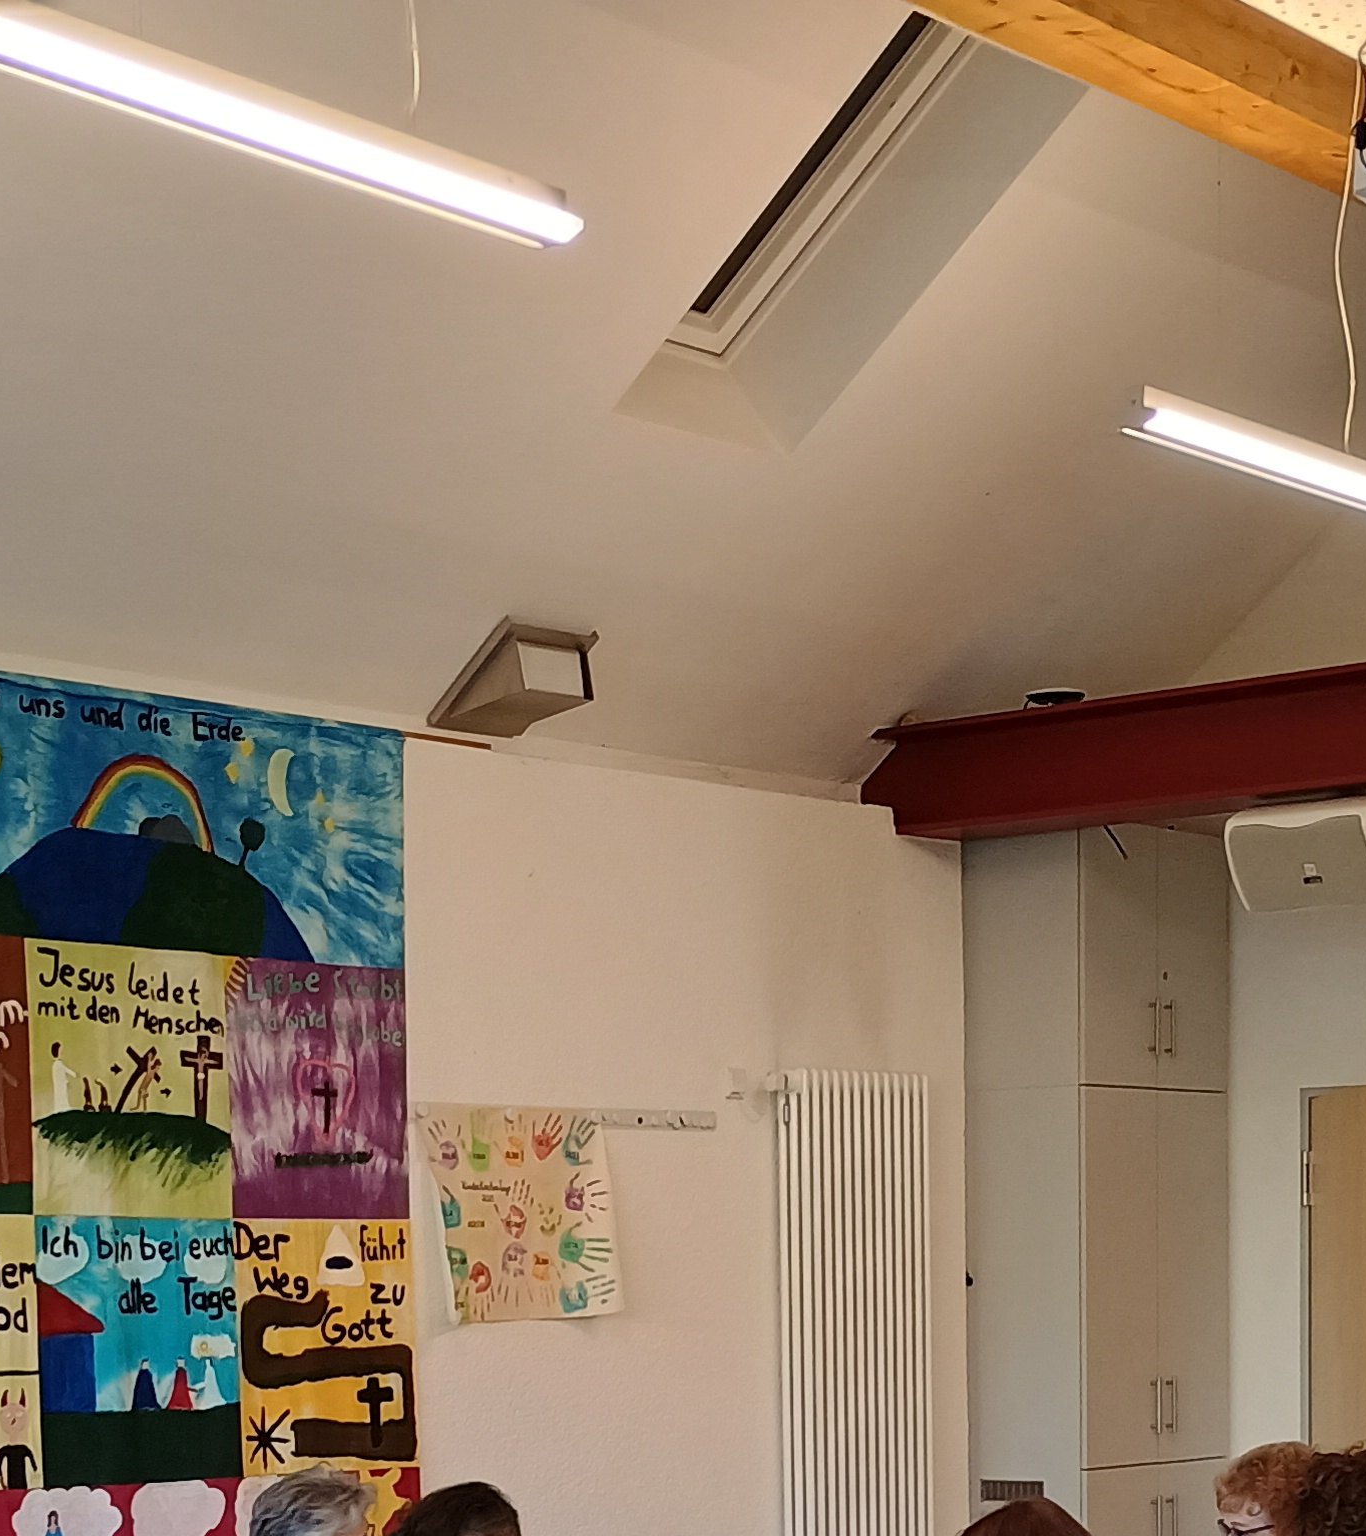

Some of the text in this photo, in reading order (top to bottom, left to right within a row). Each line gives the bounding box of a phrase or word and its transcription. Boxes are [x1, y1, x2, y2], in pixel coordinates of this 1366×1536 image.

[18, 694, 66, 719] uns
[79, 702, 125, 731] und
[137, 704, 173, 737] die
[36, 946, 201, 1006] Jesus leidet
[246, 971, 321, 1002] Liebe
[37, 996, 81, 1021] mit
[85, 995, 121, 1025] den
[40, 1224, 235, 1264] Ich bin bei euch
[233, 1220, 291, 1262] Der
[358, 1224, 407, 1263] führt
[117, 1276, 238, 1321] alle Tage
[252, 1265, 310, 1300] Weg
[320, 1306, 395, 1346] Gott
